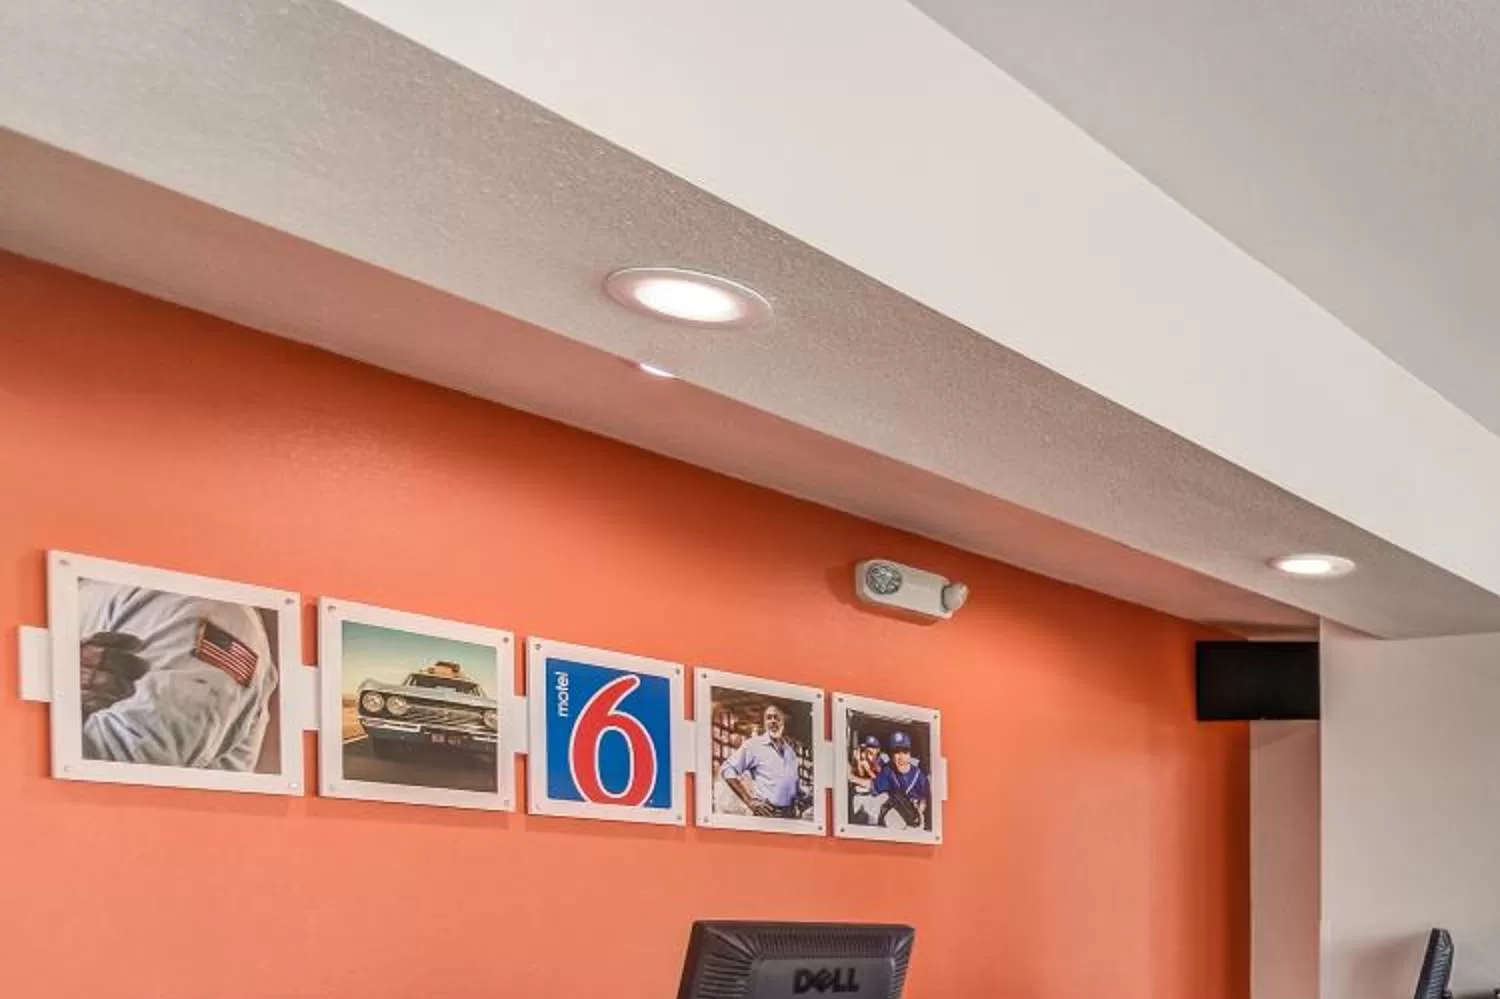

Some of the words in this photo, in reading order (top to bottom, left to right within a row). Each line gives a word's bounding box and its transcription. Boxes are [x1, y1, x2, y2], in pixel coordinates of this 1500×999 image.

[554, 671, 569, 718] motel
[568, 674, 658, 807] 6
[793, 967, 860, 994] DELL
